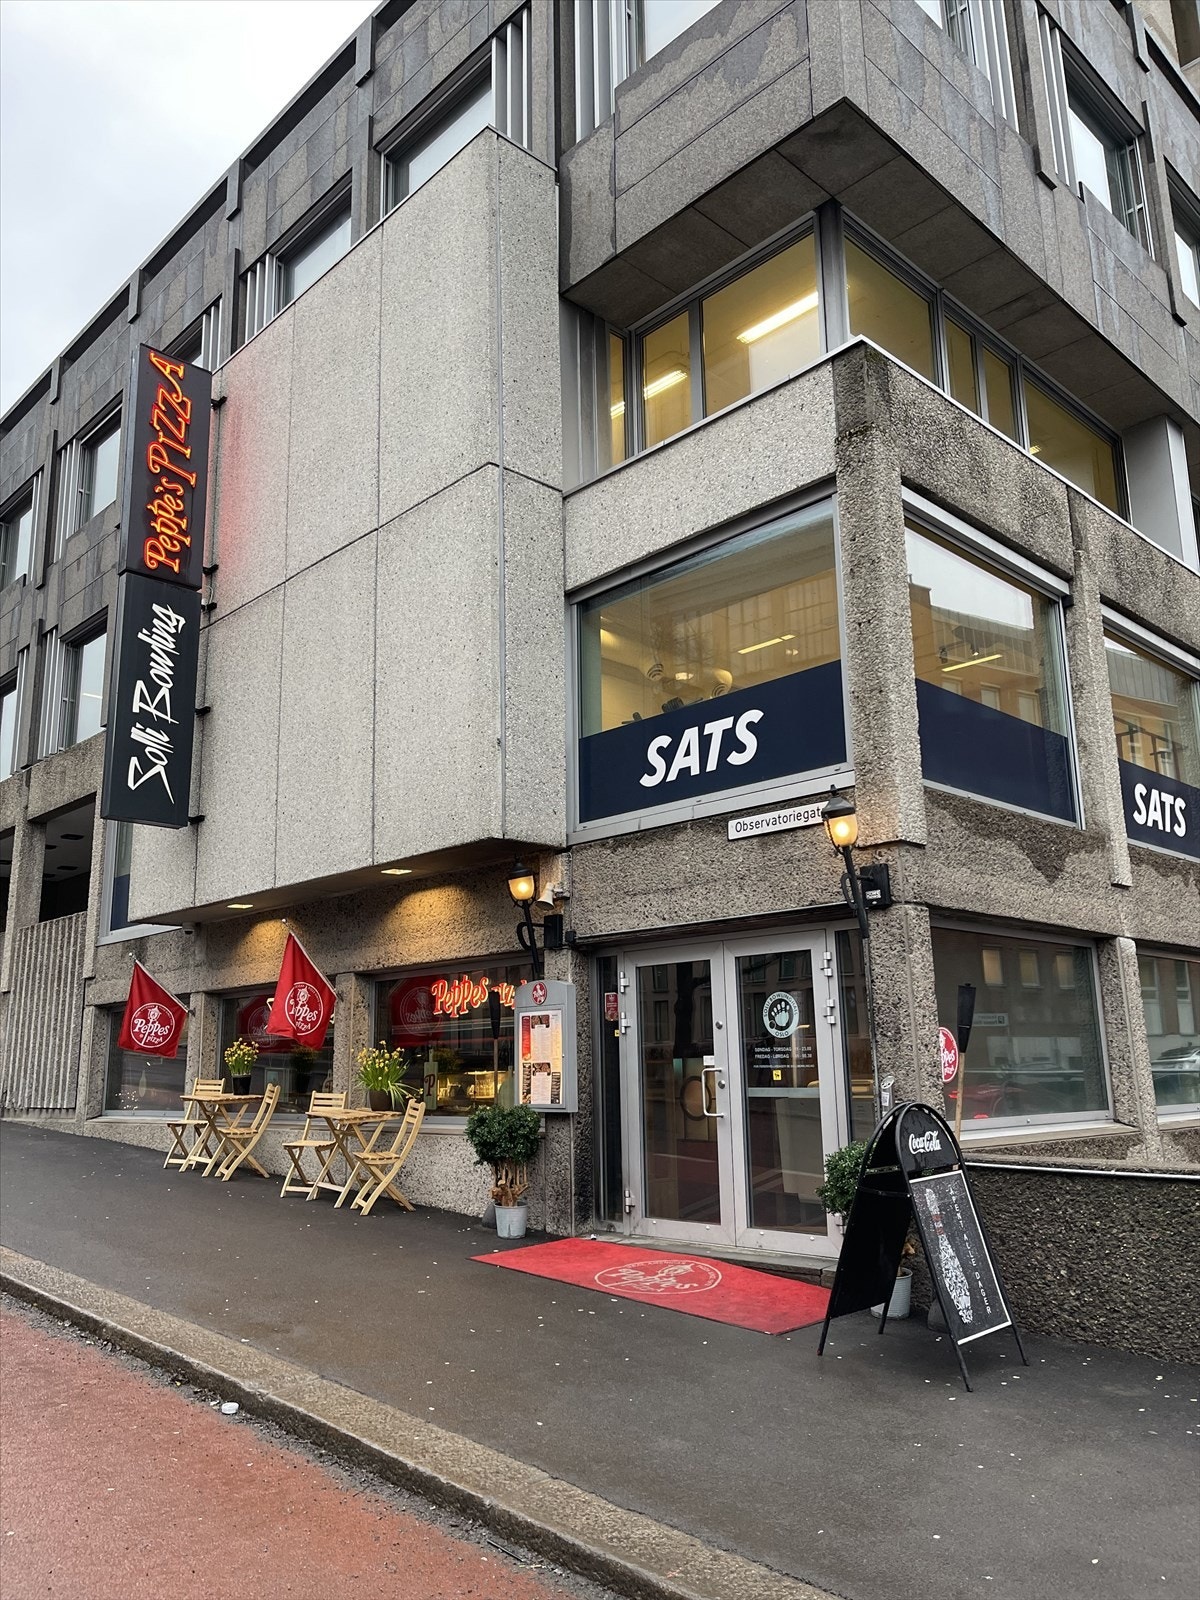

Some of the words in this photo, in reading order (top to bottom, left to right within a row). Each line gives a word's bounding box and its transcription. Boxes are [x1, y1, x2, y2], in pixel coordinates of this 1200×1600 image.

[132, 602, 187, 725] Bowling
[127, 722, 175, 805] Solli
[639, 709, 765, 788] SATS
[735, 806, 822, 833] Observatoriegat
[1132, 783, 1186, 838] SATS
[431, 974, 489, 1018] Peppes
[133, 1018, 170, 1036] Peppes
